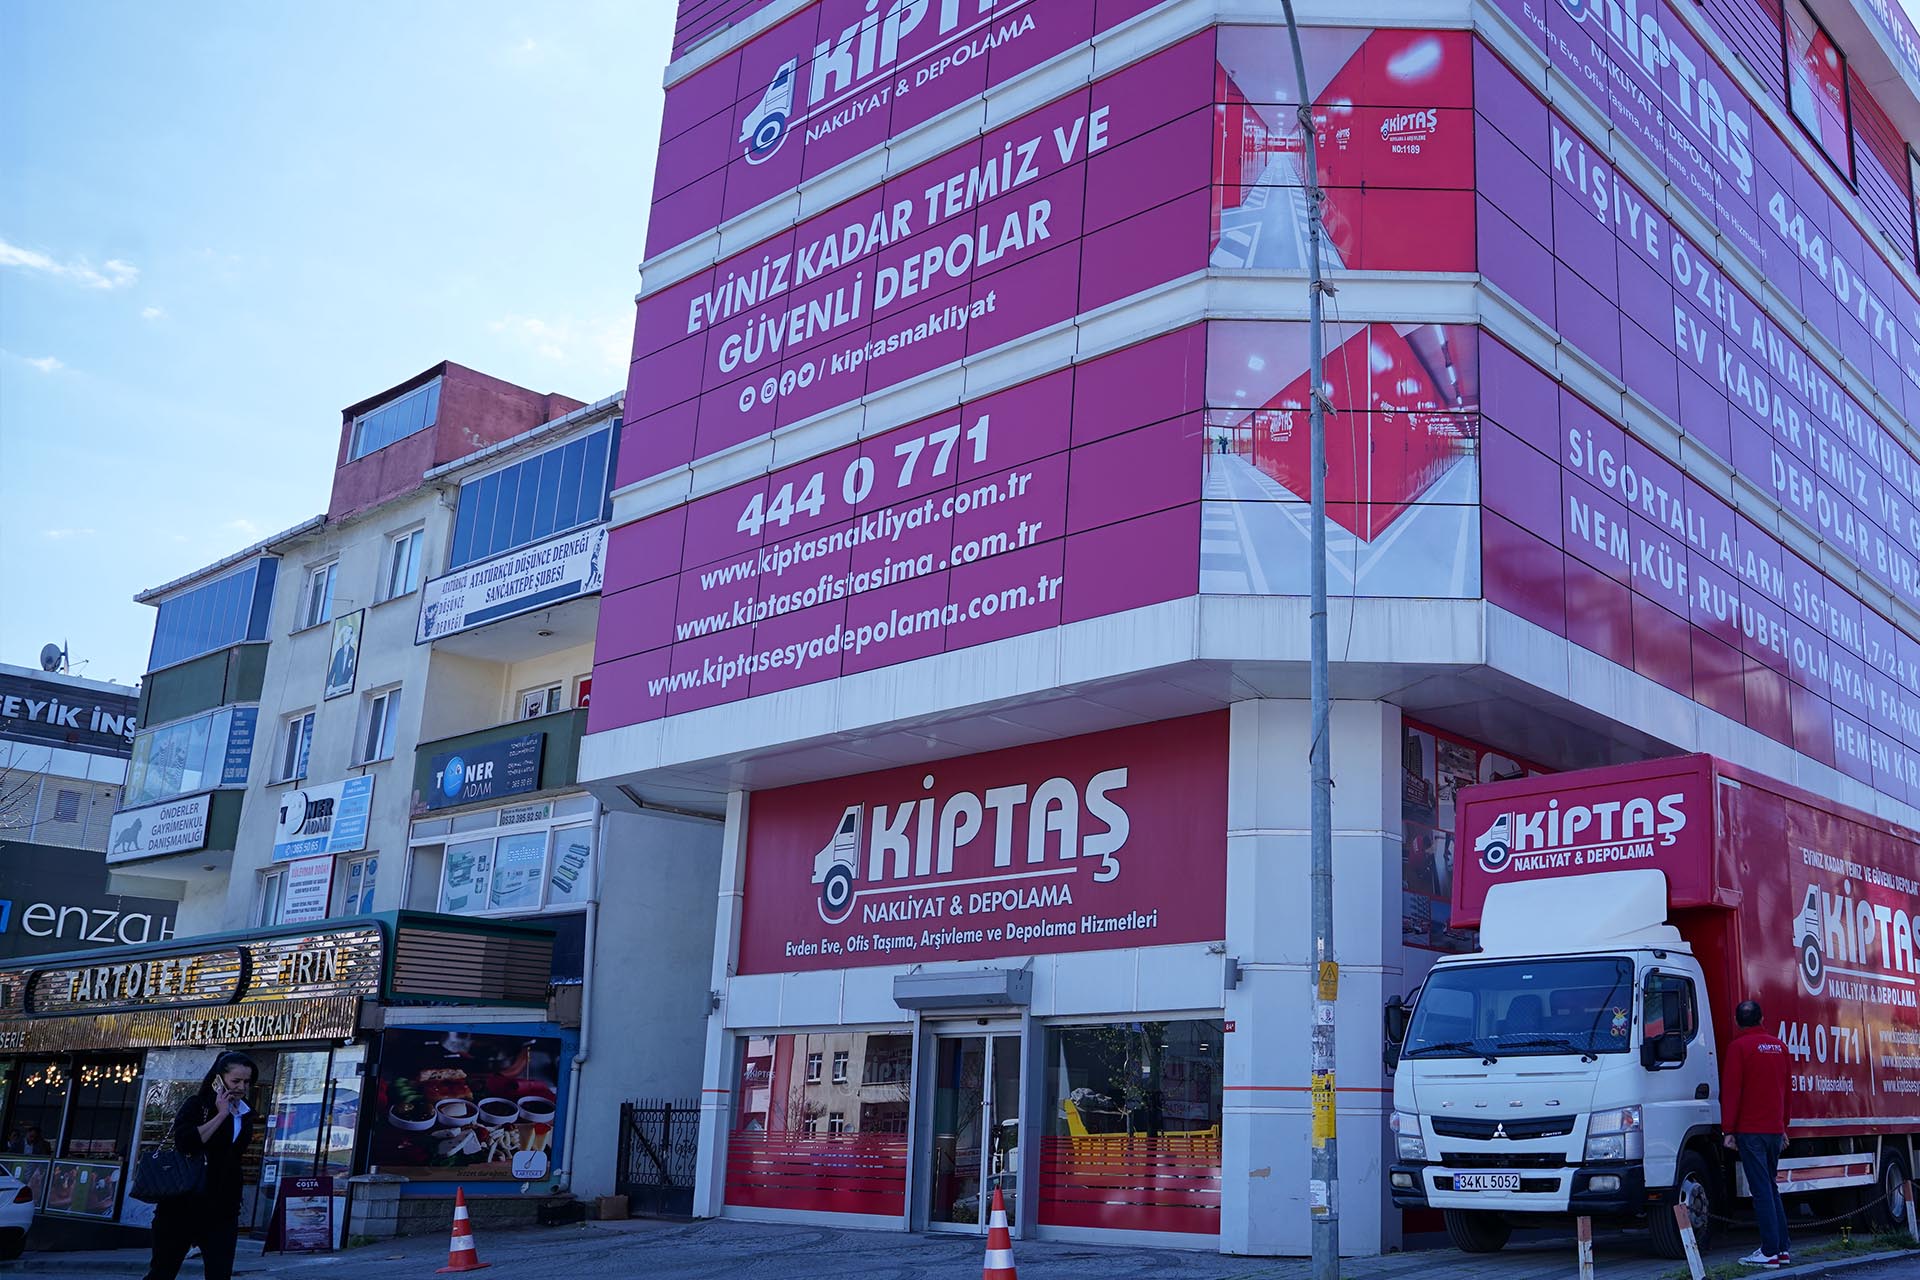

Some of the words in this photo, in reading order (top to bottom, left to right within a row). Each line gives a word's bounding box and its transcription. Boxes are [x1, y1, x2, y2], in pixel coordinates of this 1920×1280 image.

[1523, 2, 1557, 45] Evden
[1560, 39, 1582, 72] Eve,
[1584, 65, 1604, 92] Ofis
[805, 91, 890, 145] NAKLİYAT
[895, 81, 909, 98] &
[915, 13, 1035, 88] DEPOLAMA
[1389, 108, 1438, 133] KİPTAŞ
[1392, 145, 1420, 154] NO:1189
[687, 252, 793, 334] EVİNİZ
[794, 199, 913, 286] KADAR
[924, 135, 1042, 225] TEMİZ
[1053, 105, 1110, 164] VE
[718, 271, 863, 374] GÜVENLİ
[873, 199, 1052, 310] DEPOLAR
[1553, 126, 1659, 261] KİŞİYE
[1672, 233, 1742, 337] ÖZEL
[1751, 316, 1863, 448] ANAHTARI
[1768, 191, 1829, 280] 444
[1832, 255, 1850, 304] 0
[1852, 275, 1898, 358] 771
[830, 289, 997, 377] kiptasnakliyat
[1674, 304, 1707, 365] EV
[1717, 343, 1802, 449] KADAR
[1805, 421, 1868, 506] TEMİZ
[1877, 485, 1901, 535] VE
[736, 471, 826, 537] 444
[841, 456, 875, 506] 0
[894, 414, 990, 489] 771
[1569, 428, 1706, 550] SİGORTALI
[700, 469, 1032, 591] www.kiptasnakliyat.com.tr
[1770, 449, 1871, 561] DEPOLAR
[468, 557, 513, 589] ATATÜRKÇÜ
[514, 549, 551, 575] DÜŞÜNCE
[552, 532, 590, 562] DERNEĞİ
[485, 576, 534, 603] SANCAKTEPE
[535, 560, 566, 592] ŞUBESİ
[648, 573, 1064, 697] www.kiptasesyadepolama.com.tr
[0, 695, 82, 729] EYİK
[1834, 717, 1890, 775] HEMEN
[160, 803, 199, 821] ÖNDERLER
[462, 782, 492, 799] ADAM
[151, 816, 204, 836] GAYRİMENKUL
[868, 767, 1131, 882] KİPTAŞ
[1515, 793, 1687, 846] KİPTAŞ
[1574, 851, 1584, 865] &
[1587, 843, 1654, 864] DEPOLAMA
[22, 902, 152, 945] enza
[863, 894, 945, 924] NAKLİYAT
[949, 895, 964, 917] &
[968, 883, 1073, 915] DEPOLAMA
[785, 940, 818, 957] Evden
[821, 939, 843, 955] Eve,
[846, 934, 870, 951] Ofis
[872, 933, 917, 954] Taşıma,
[920, 925, 983, 951] Arşivleme
[987, 928, 1002, 942] ve
[1006, 916, 1076, 942] Depolama
[1080, 909, 1158, 934] Hizmetleri
[66, 958, 193, 1002] TARTOLET
[1877, 989, 1917, 1008] DEPOLAMA
[173, 1020, 205, 1041] CAFE
[205, 1019, 214, 1039] &
[217, 1012, 303, 1039] RESTAURANT
[1815, 1023, 1827, 1063] 0
[1830, 1026, 1860, 1064] 771
[1460, 1175, 1473, 1188] 34
[1475, 1175, 1488, 1189] KL
[1491, 1175, 1519, 1189] 5052
